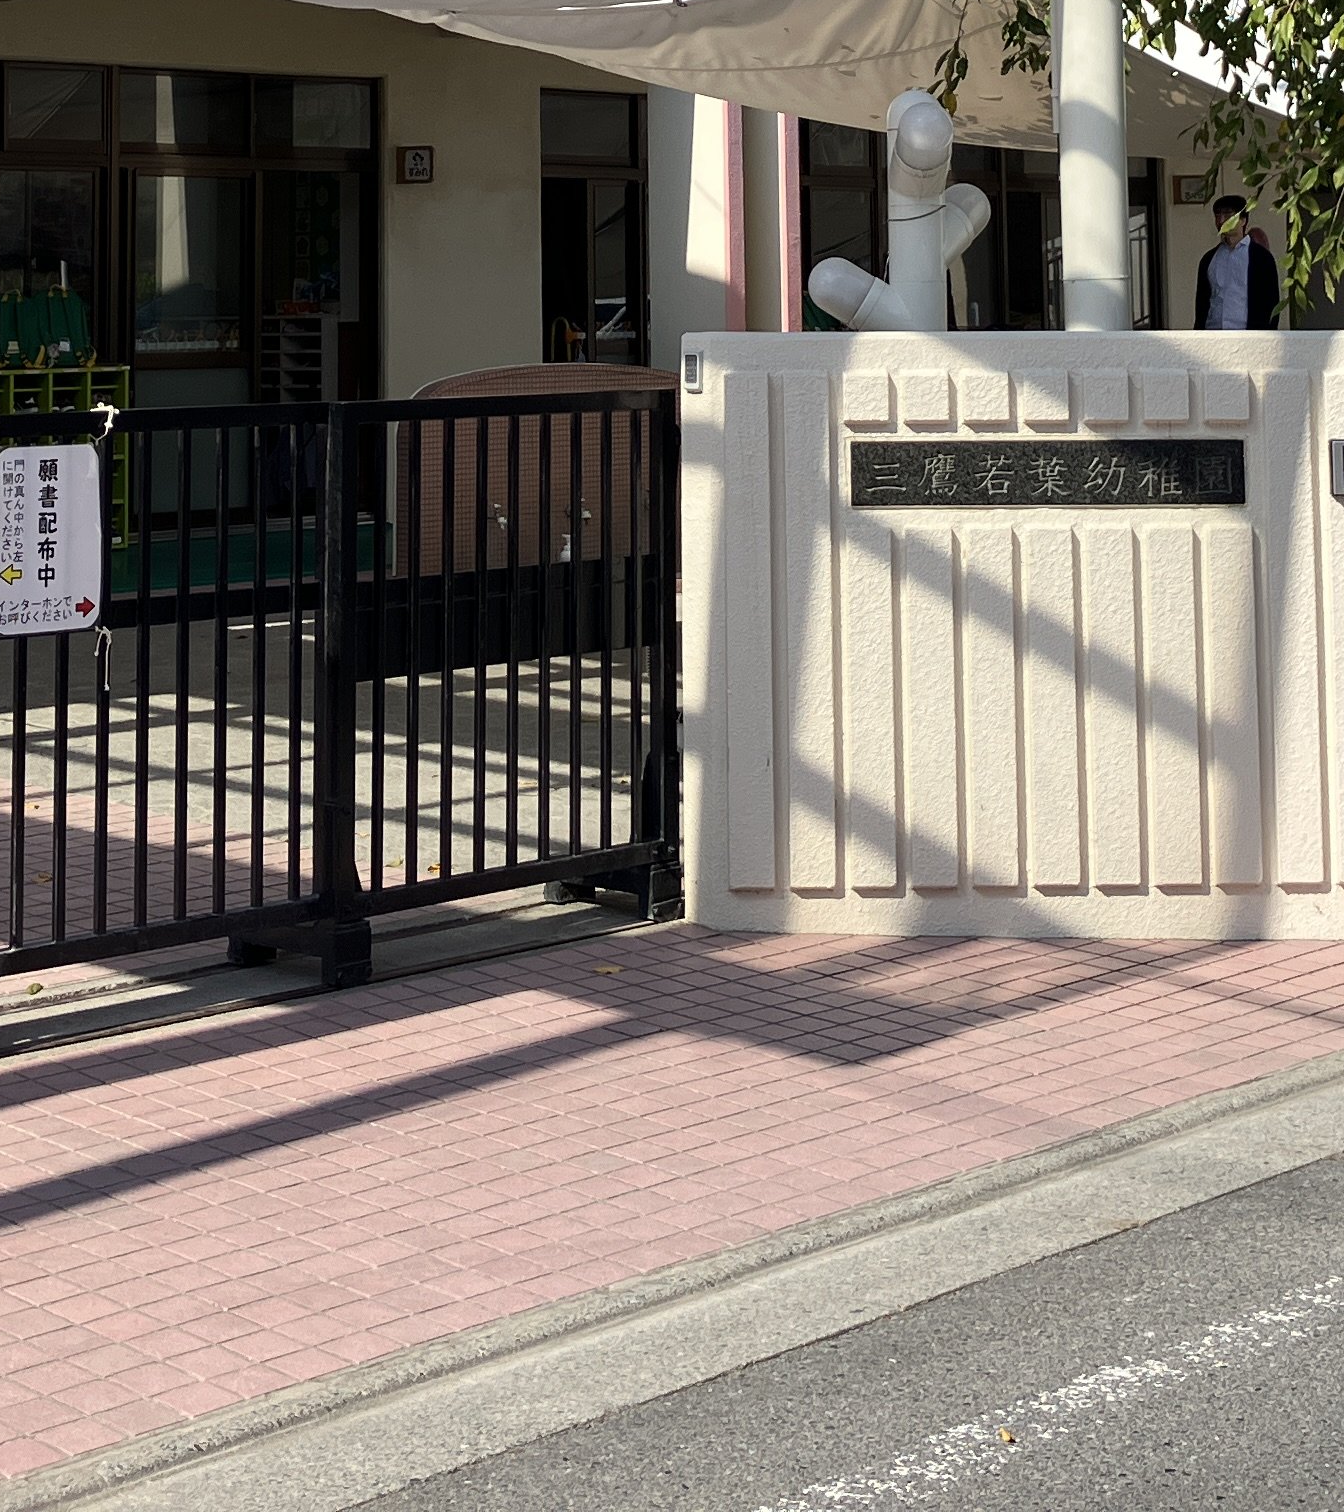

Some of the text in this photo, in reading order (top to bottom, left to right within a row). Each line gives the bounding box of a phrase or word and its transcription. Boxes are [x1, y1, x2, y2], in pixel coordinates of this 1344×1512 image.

[1, 460, 14, 563] に開けてください
[13, 459, 25, 562] 門の真ん中から左
[38, 459, 58, 588] 願書配布中
[865, 452, 1233, 497] 三鷹若葉幼稚園
